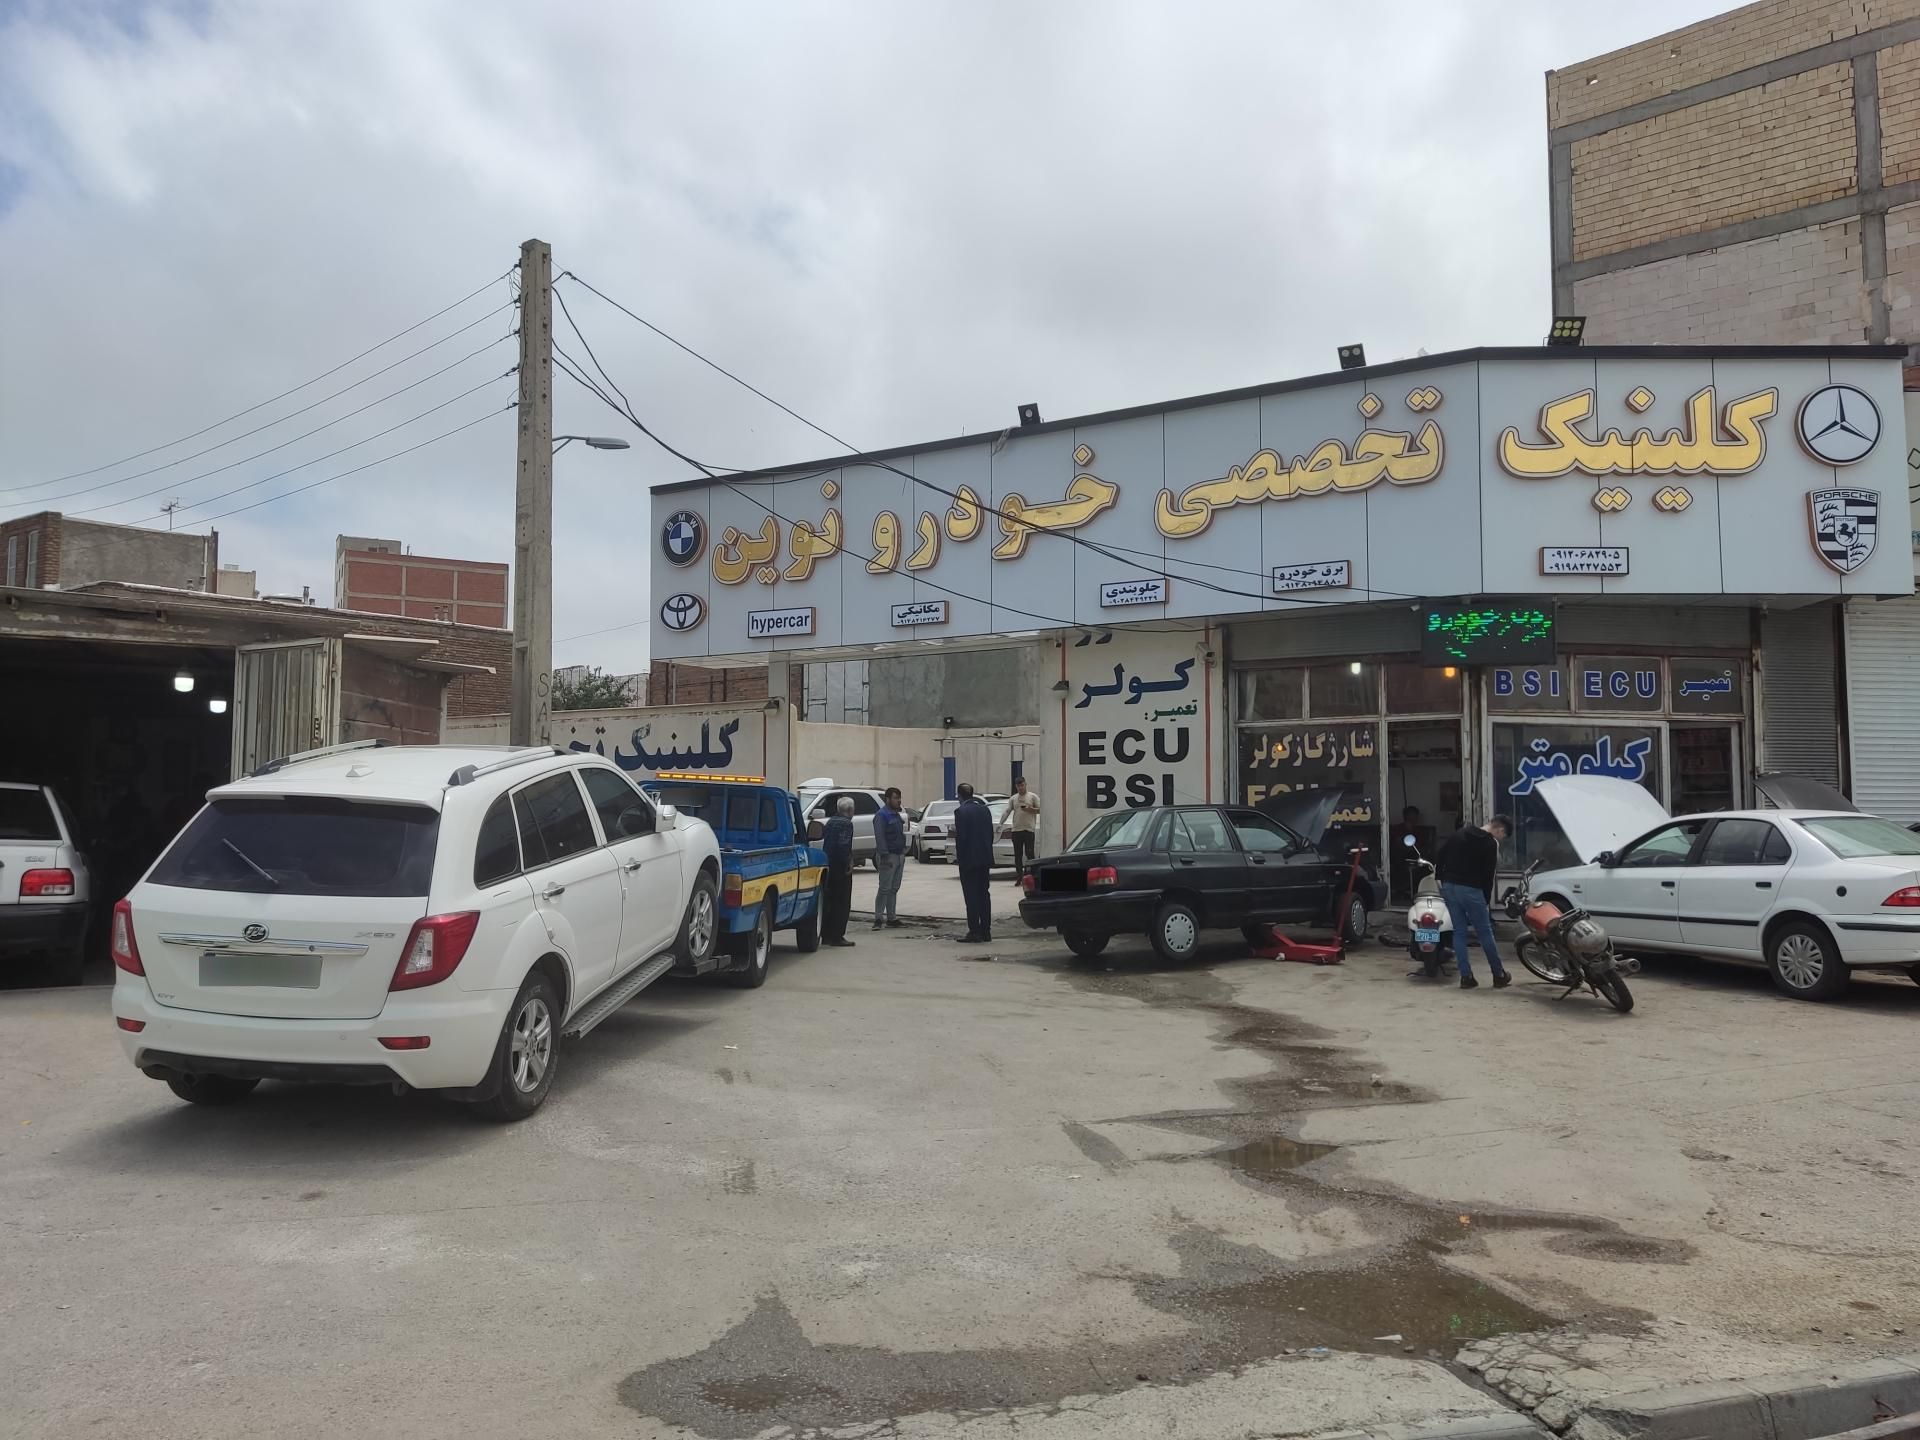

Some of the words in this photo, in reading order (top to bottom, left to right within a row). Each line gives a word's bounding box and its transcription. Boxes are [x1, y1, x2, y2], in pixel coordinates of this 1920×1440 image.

[1154, 385, 1446, 539] تخصصی
[1498, 385, 1780, 514] کلینیک
[865, 443, 1120, 574] خودرو
[1814, 491, 1876, 501] PORSCHE
[666, 513, 698, 531] BMW
[712, 479, 843, 585] نوین
[1278, 565, 1318, 581] خودرو
[1321, 565, 1344, 576] برق
[1106, 582, 1161, 598] جلوبندی
[751, 615, 810, 634] hypercar
[897, 604, 940, 618] مکانیکی
[1074, 657, 1196, 709] کولر
[1494, 669, 1560, 697] BSI
[1584, 670, 1656, 698] ECU
[1679, 670, 1733, 701] تعمیر
[1078, 727, 1190, 765] ECU
[1249, 733, 1294, 769] کولر
[1293, 732, 1326, 767] گاز
[1327, 730, 1374, 767] شارژ
[1086, 773, 1175, 809] BSI
